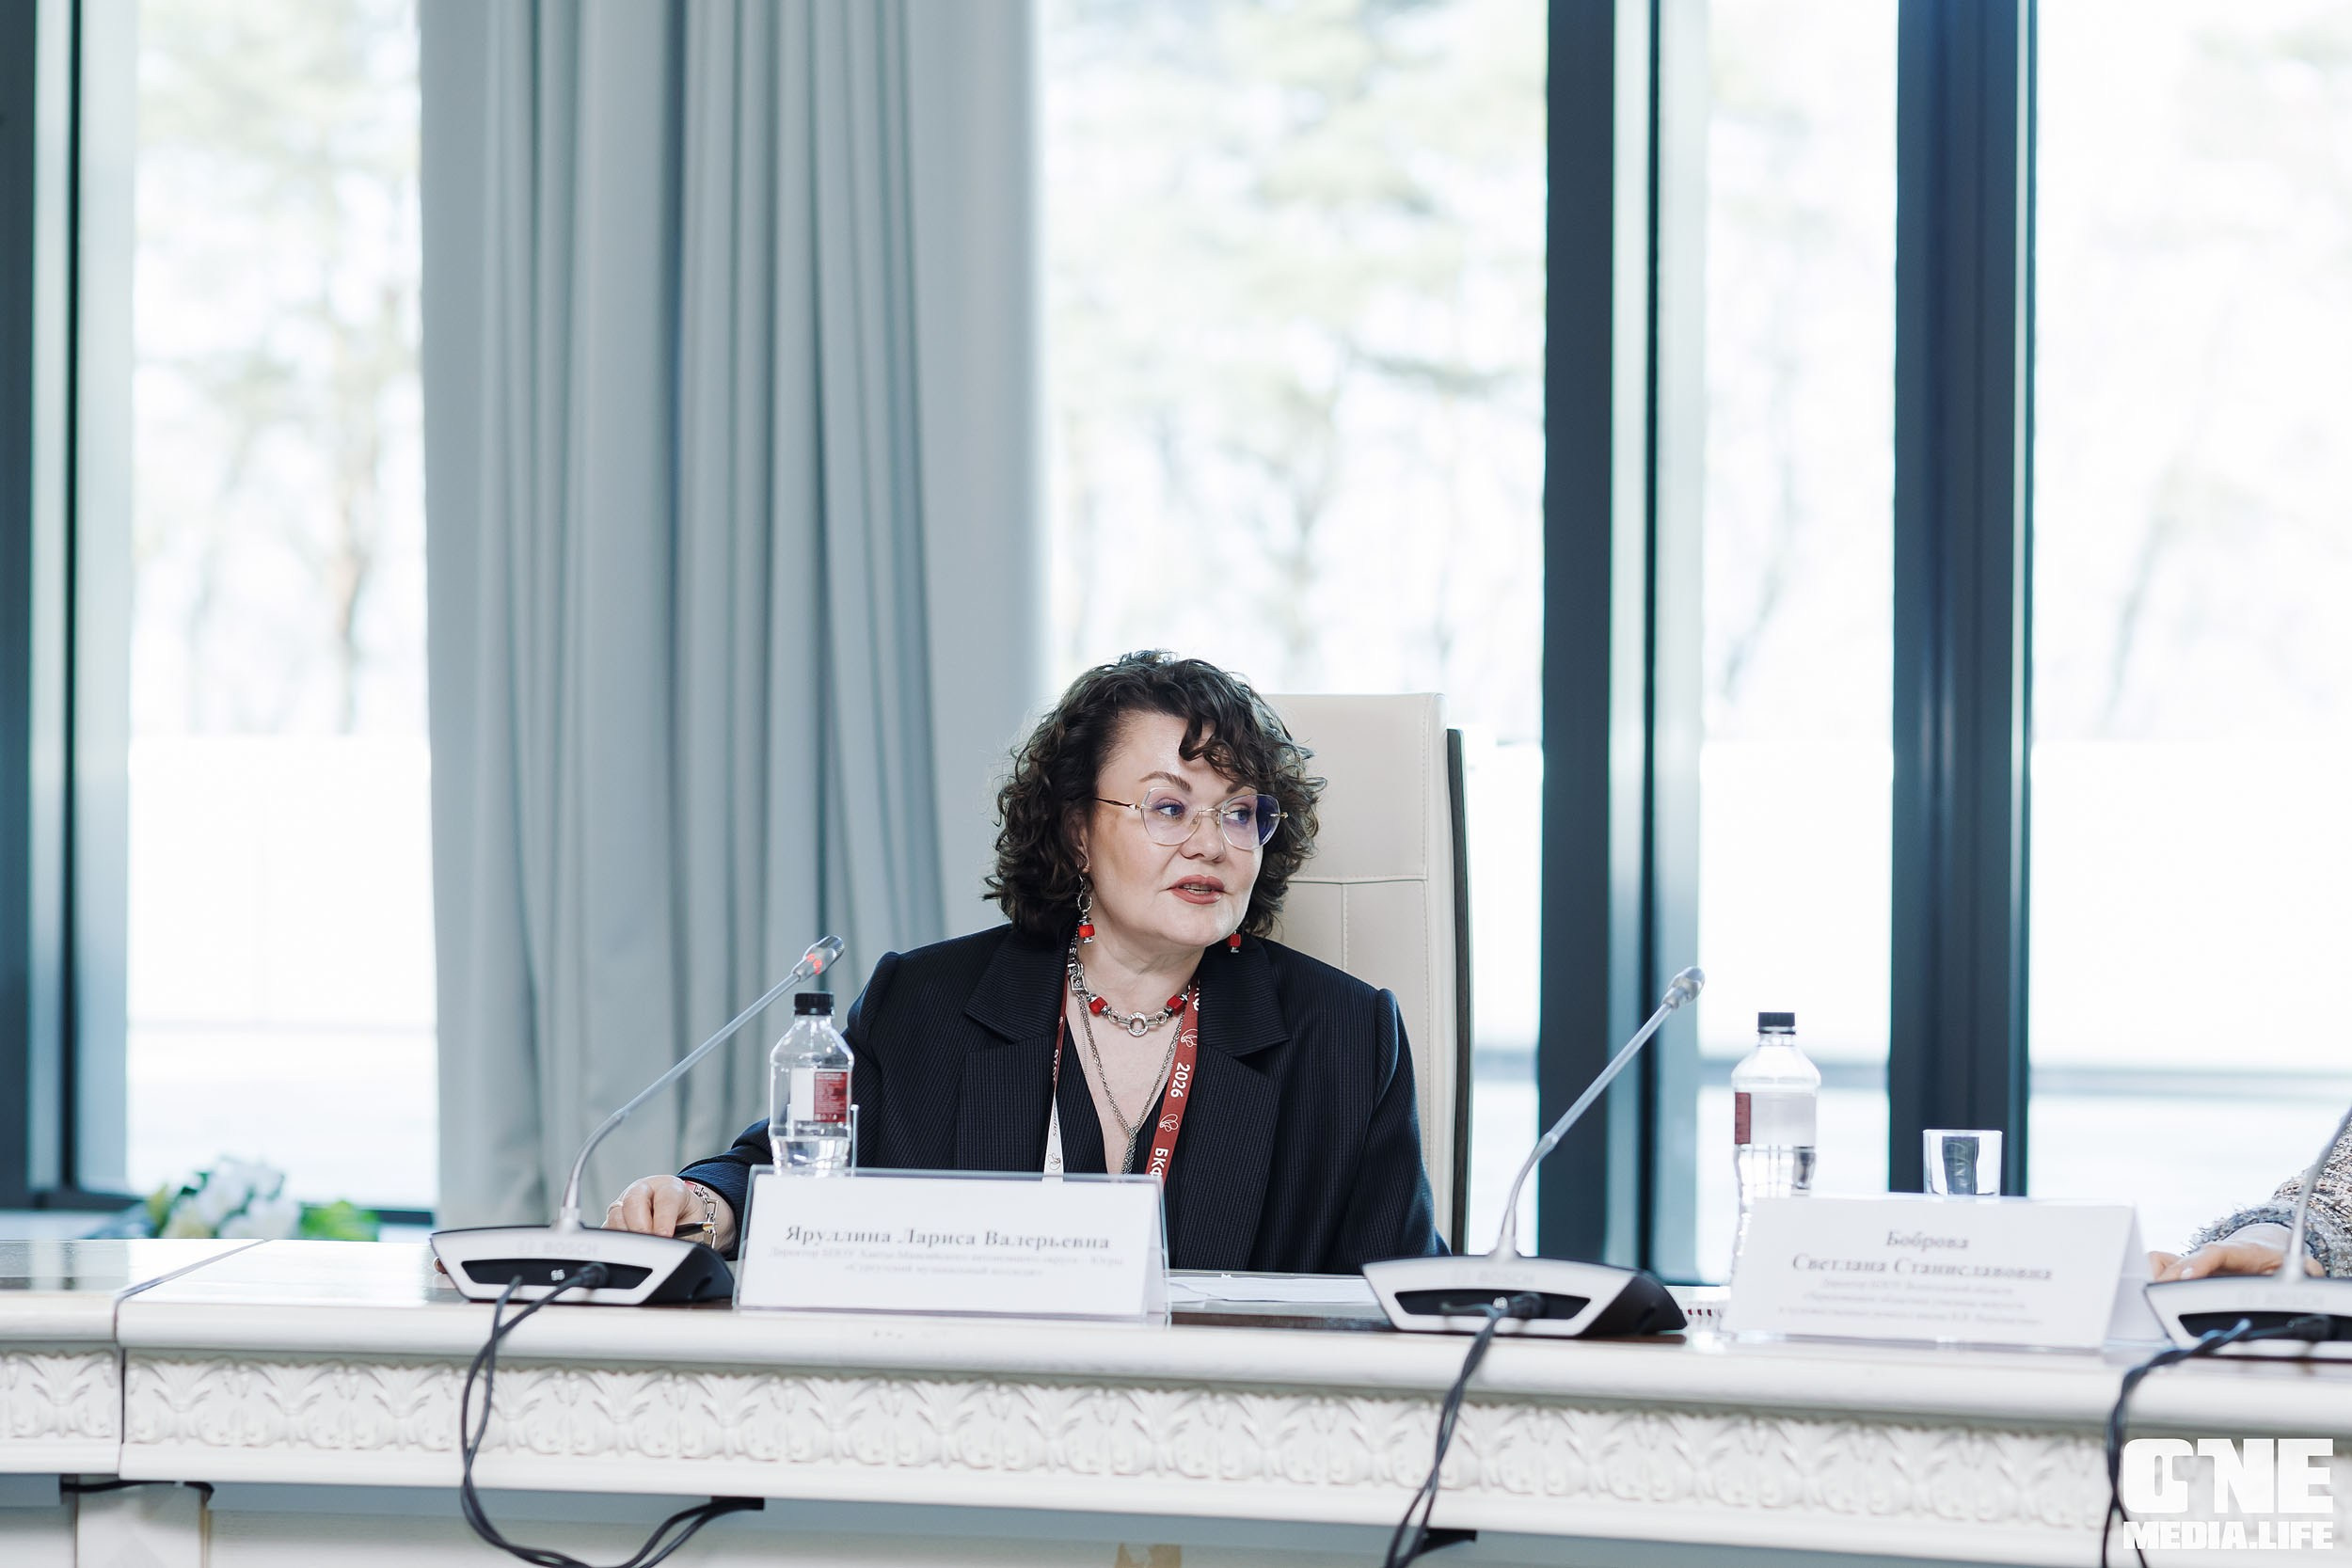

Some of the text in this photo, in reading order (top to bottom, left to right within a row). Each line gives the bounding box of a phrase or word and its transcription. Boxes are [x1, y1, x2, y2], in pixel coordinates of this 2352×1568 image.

[1170, 1062, 1191, 1098] 2026
[786, 1226, 1110, 1251] Яруллина Лариса Валерьевна
[1886, 1229, 1968, 1252] Боброва
[1792, 1253, 2053, 1281] Светлана Станиславовна
